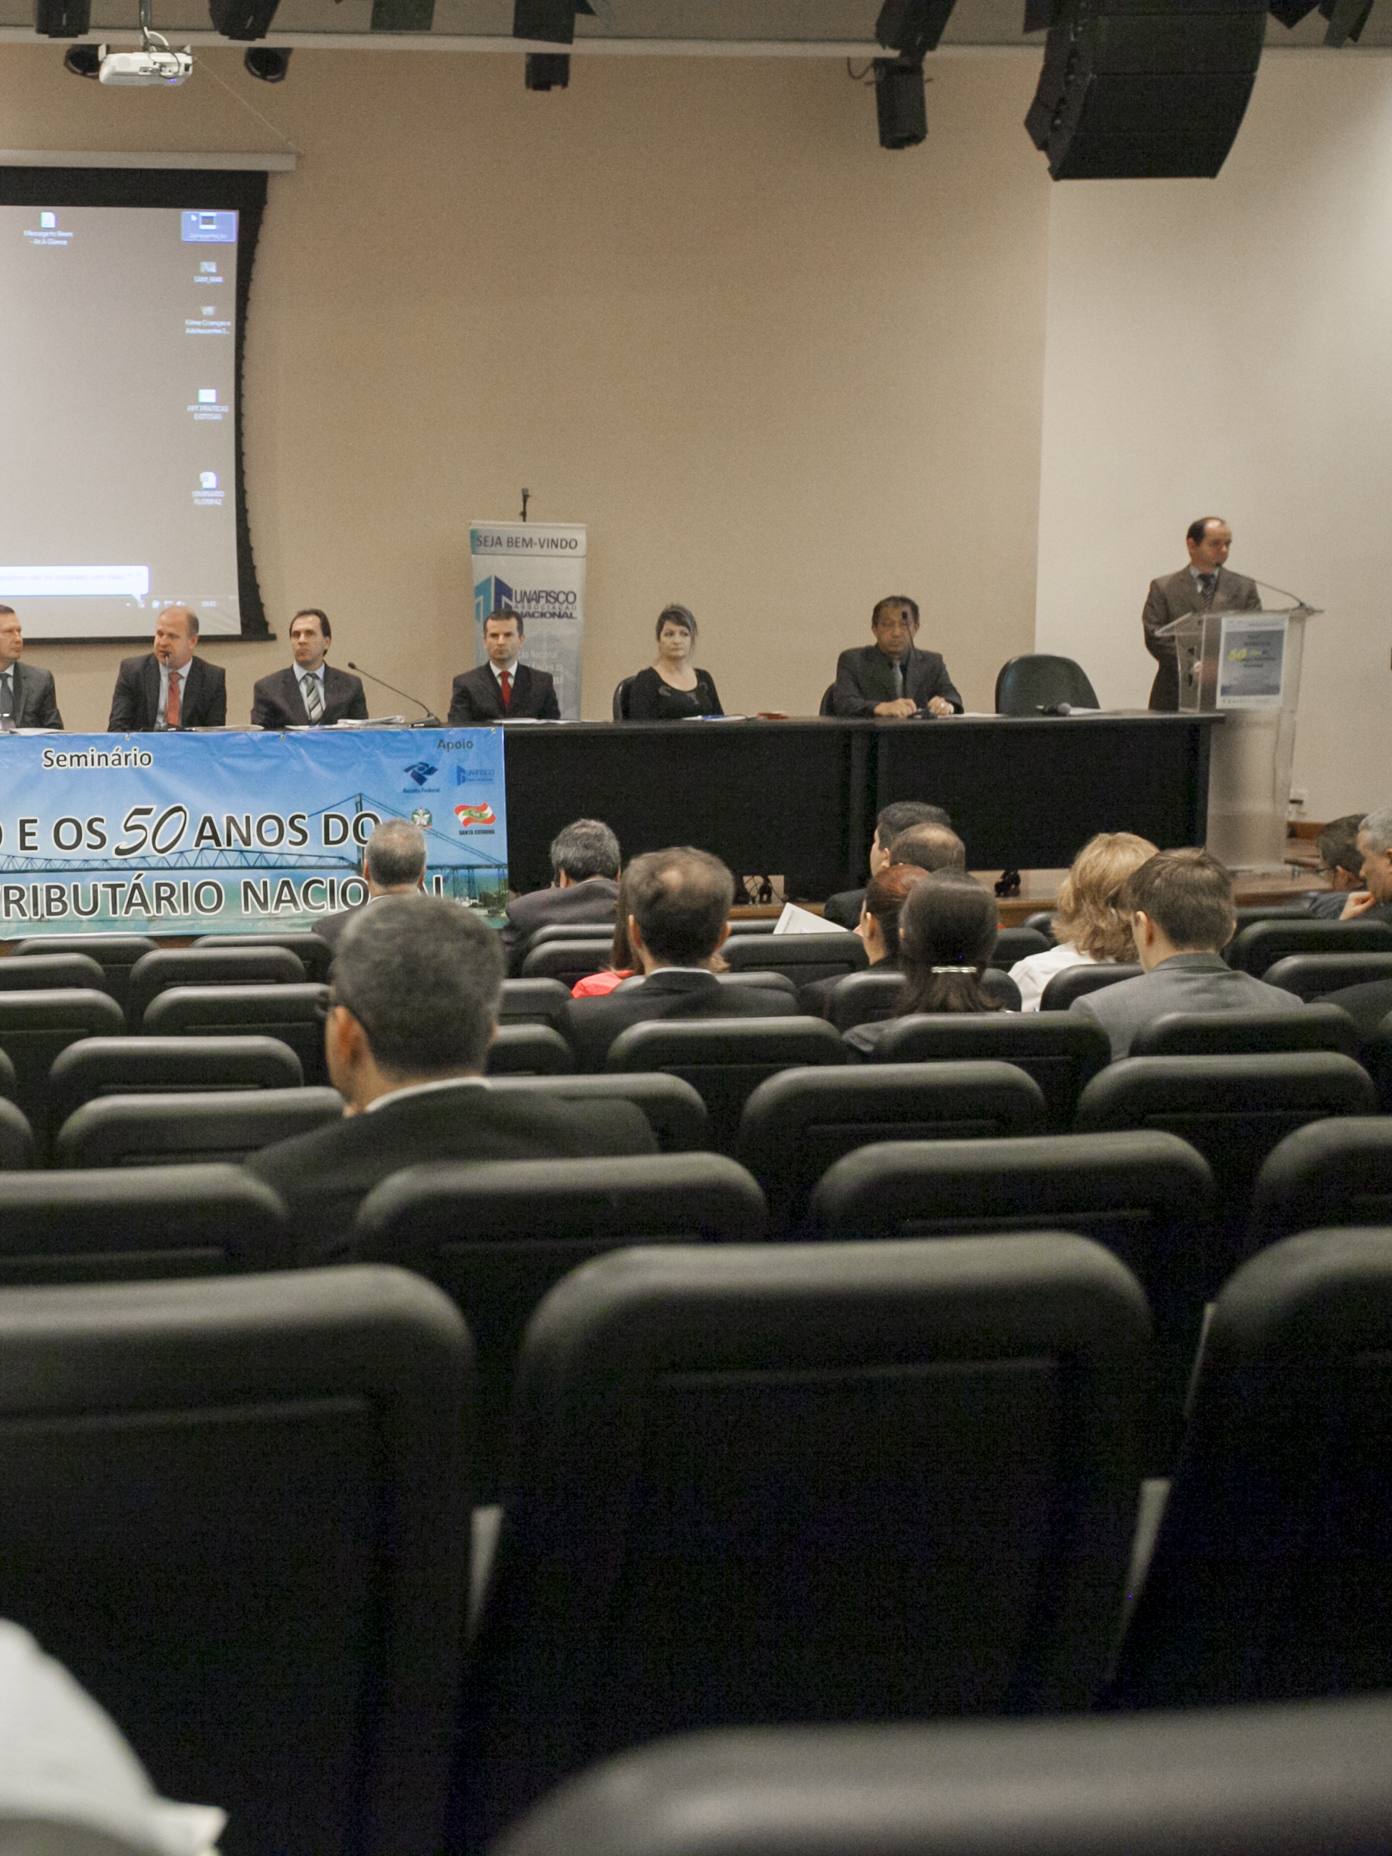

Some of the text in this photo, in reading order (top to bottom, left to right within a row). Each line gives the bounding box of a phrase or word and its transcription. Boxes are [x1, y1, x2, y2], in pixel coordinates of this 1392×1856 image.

[476, 534, 578, 550] SEJA BEM-VINDO
[514, 589, 577, 605] UNAFISCO
[437, 739, 474, 752] Apoio
[42, 746, 153, 769] Seminário
[18, 817, 39, 851] E
[53, 816, 108, 852] OS
[114, 803, 188, 857] 50
[193, 812, 309, 850] ANOS
[321, 811, 383, 847] DO
[241, 874, 444, 916] NACIO
